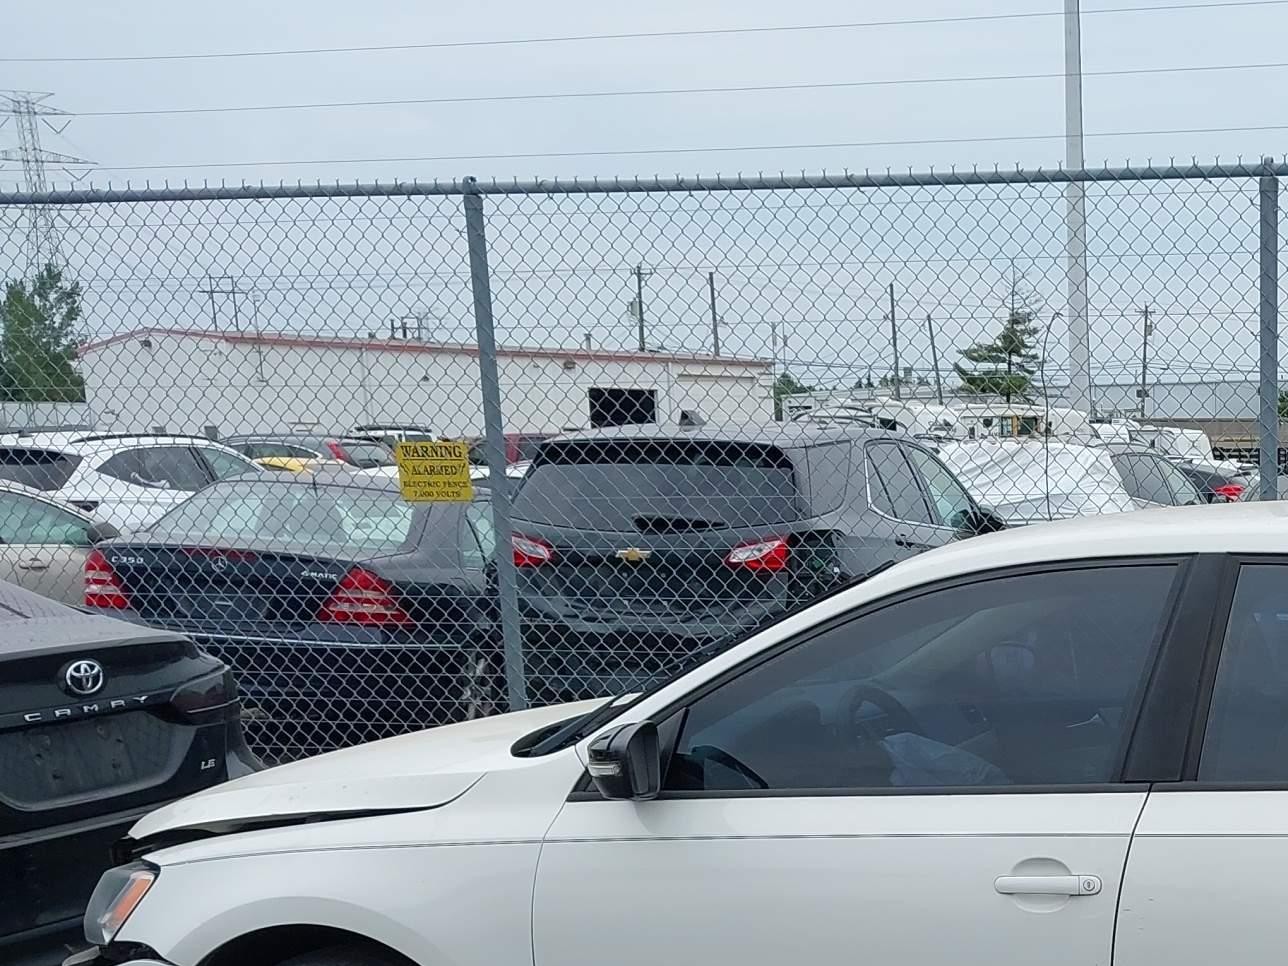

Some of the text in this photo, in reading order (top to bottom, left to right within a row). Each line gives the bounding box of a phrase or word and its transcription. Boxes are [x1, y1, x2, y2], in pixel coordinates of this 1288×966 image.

[400, 445, 462, 458] WARNING
[411, 464, 458, 476] ALARMED
[403, 480, 441, 488] ELECTRIC
[436, 490, 461, 498] VOLTS
[24, 696, 148, 722] CAMRY
[200, 758, 216, 771] LE
